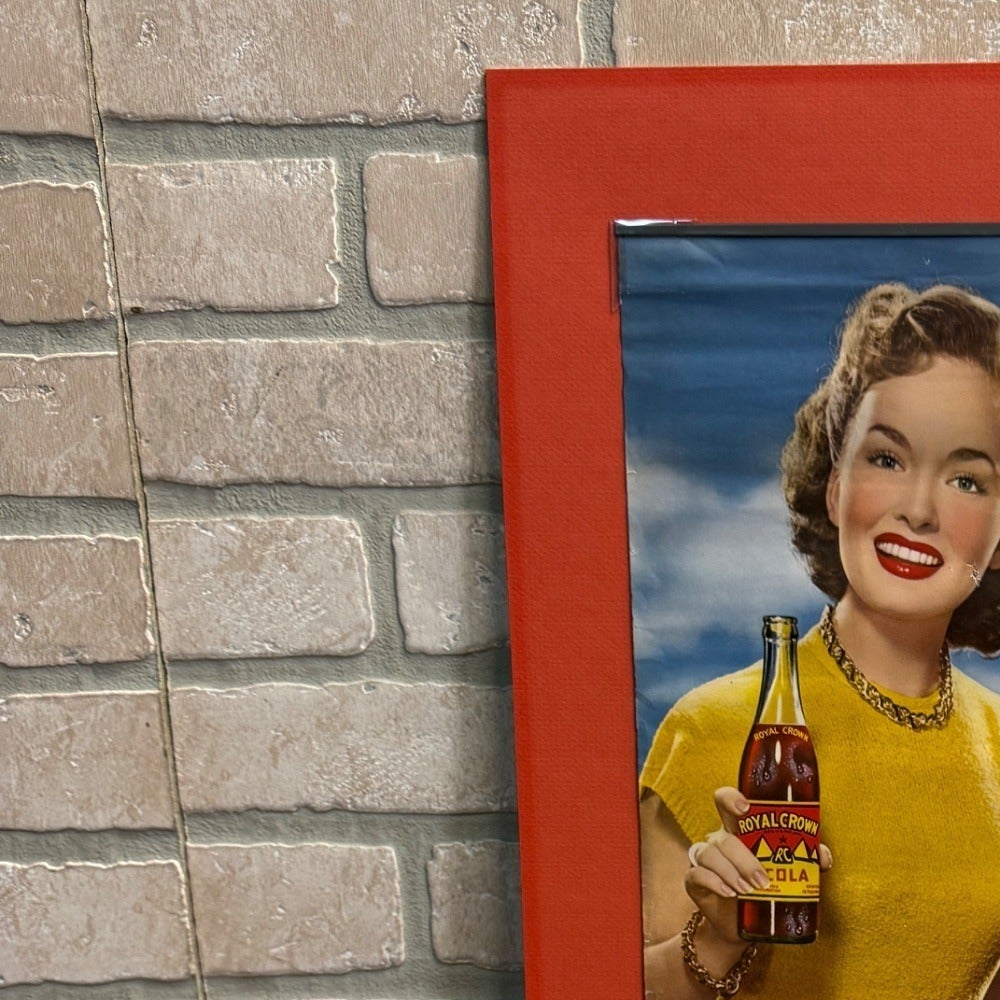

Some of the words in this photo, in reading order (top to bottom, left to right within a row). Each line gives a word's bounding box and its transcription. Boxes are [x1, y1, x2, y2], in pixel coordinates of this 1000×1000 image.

[753, 726, 779, 742] ROYAL
[782, 726, 809, 742] CROWN
[738, 812, 779, 834] ROYAL
[780, 812, 819, 836] CROWN
[775, 847, 792, 862] RC
